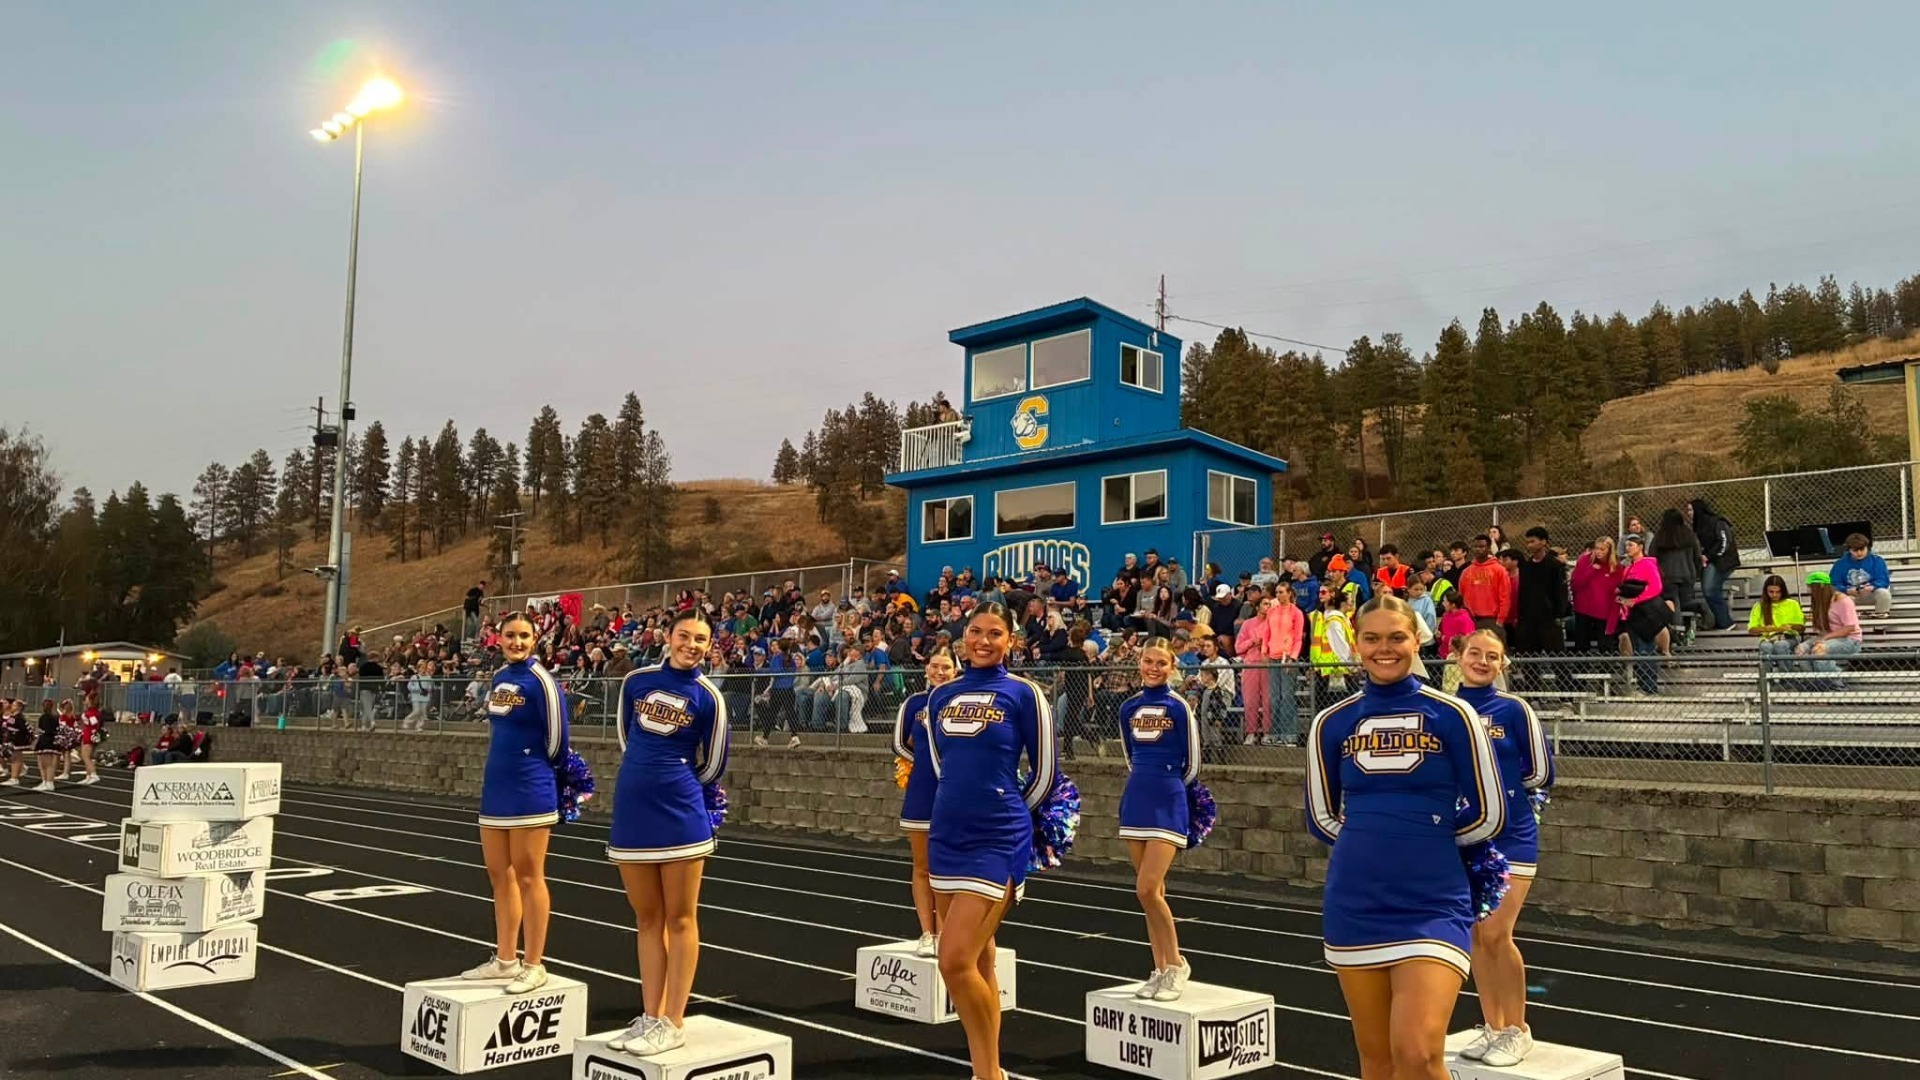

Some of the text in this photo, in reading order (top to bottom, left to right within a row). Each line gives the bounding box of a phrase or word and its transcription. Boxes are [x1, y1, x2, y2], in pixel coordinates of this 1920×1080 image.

[1016, 394, 1049, 450] C
[983, 539, 1090, 595] BULLDOGS
[634, 699, 695, 727] BULLDOGS
[938, 705, 1005, 723] ULLDOGS
[142, 781, 215, 800] ACKERMAN
[171, 791, 211, 800] NOLAN
[177, 847, 262, 862] WOODBRIDGE
[195, 859, 246, 870] Real Estate
[126, 881, 184, 900] COLFAX
[151, 943, 190, 963] EMPIRE
[198, 937, 248, 958] DISPOSAL
[871, 956, 917, 986] Colfax
[422, 995, 451, 1012] FOLSOM
[510, 994, 566, 1013] FOLSOM
[870, 997, 916, 1014] BODY REPAIR
[410, 1002, 448, 1045] ACE
[483, 1007, 562, 1051] ACE
[1093, 1006, 1182, 1045] GARY & TRUDY
[410, 1037, 447, 1062] Hardware
[484, 1043, 560, 1067] Hardware
[1119, 1040, 1153, 1068] LIBEY
[1228, 1045, 1261, 1069] Pizza
